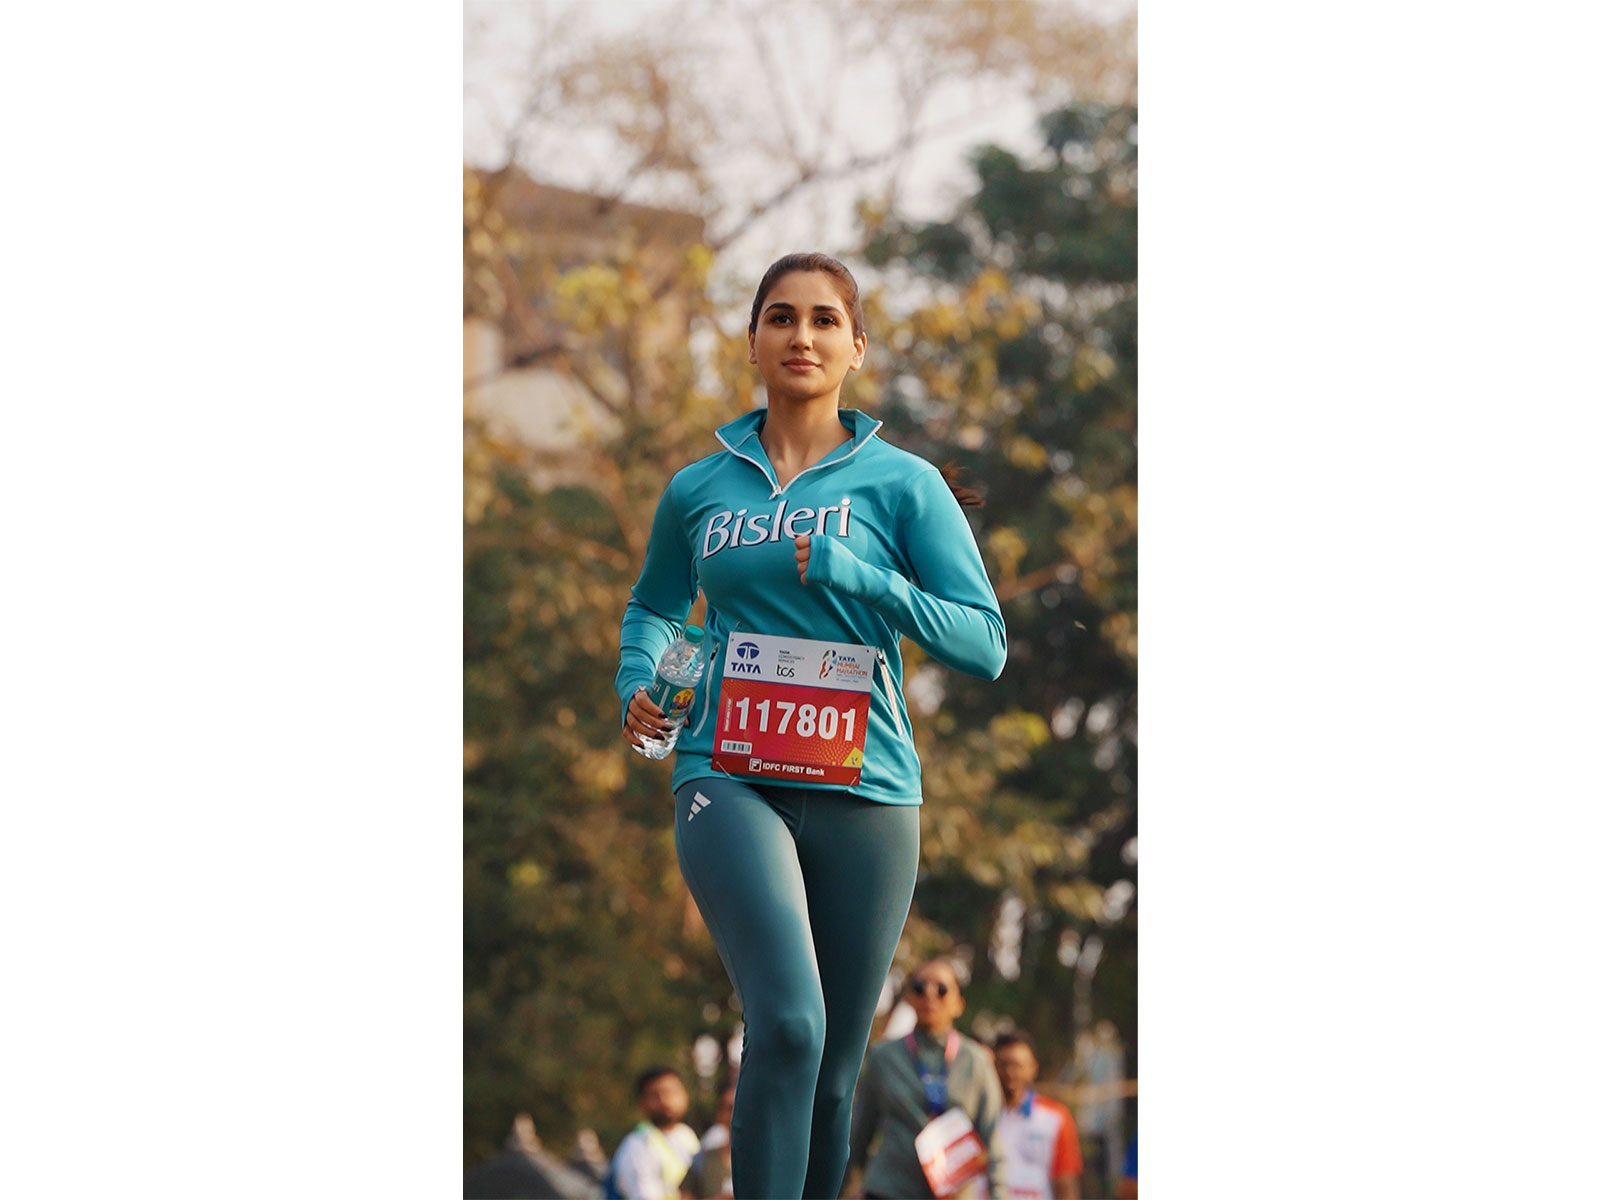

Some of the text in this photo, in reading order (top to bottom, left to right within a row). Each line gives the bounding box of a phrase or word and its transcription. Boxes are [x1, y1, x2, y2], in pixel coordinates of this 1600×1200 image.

[702, 497, 851, 561] Bisleri
[731, 662, 761, 674] TATA
[776, 664, 795, 677] tcs
[836, 668, 868, 676] MARATHON
[736, 697, 856, 741] 117801
[763, 763, 780, 771] IDFC
[782, 764, 804, 773] FIRST
[806, 767, 825, 776] Bank
